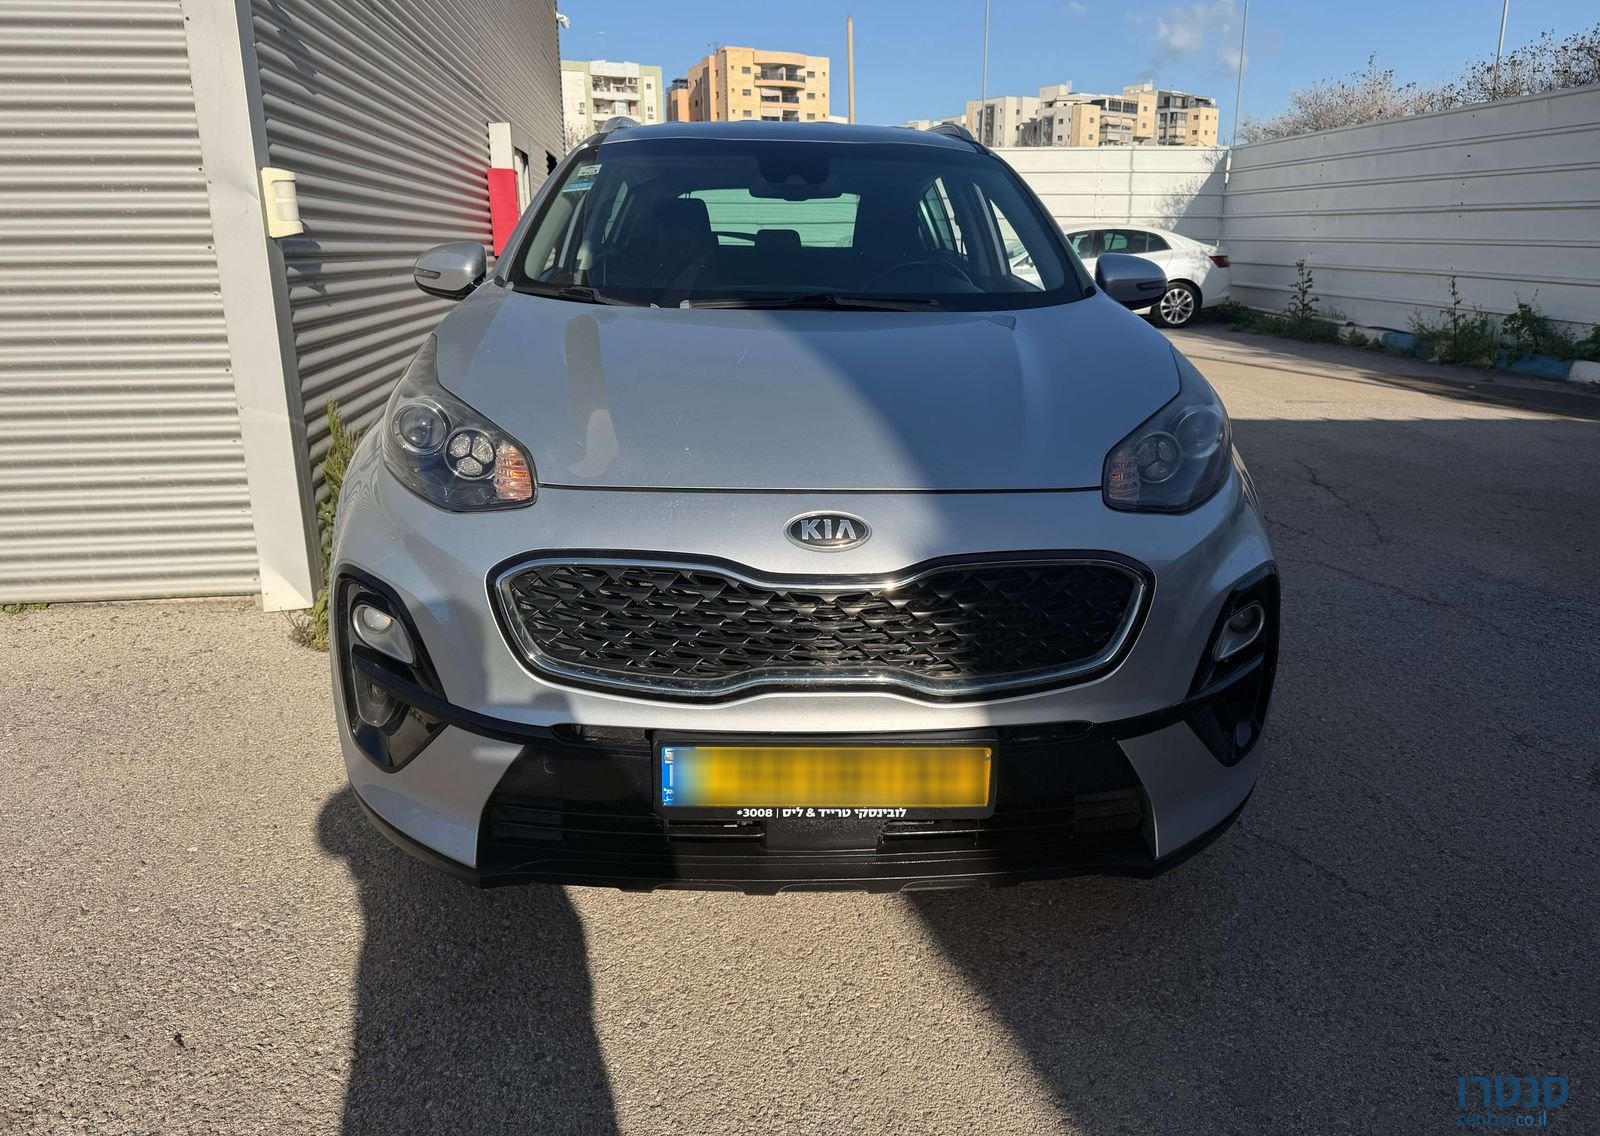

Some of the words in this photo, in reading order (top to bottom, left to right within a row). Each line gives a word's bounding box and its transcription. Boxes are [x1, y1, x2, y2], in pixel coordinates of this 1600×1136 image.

[800, 519, 857, 540] KIA
[782, 806, 804, 818] ליס
[805, 808, 816, 818] &
[817, 808, 851, 818] טרייד
[854, 807, 907, 819] לובינסקי
